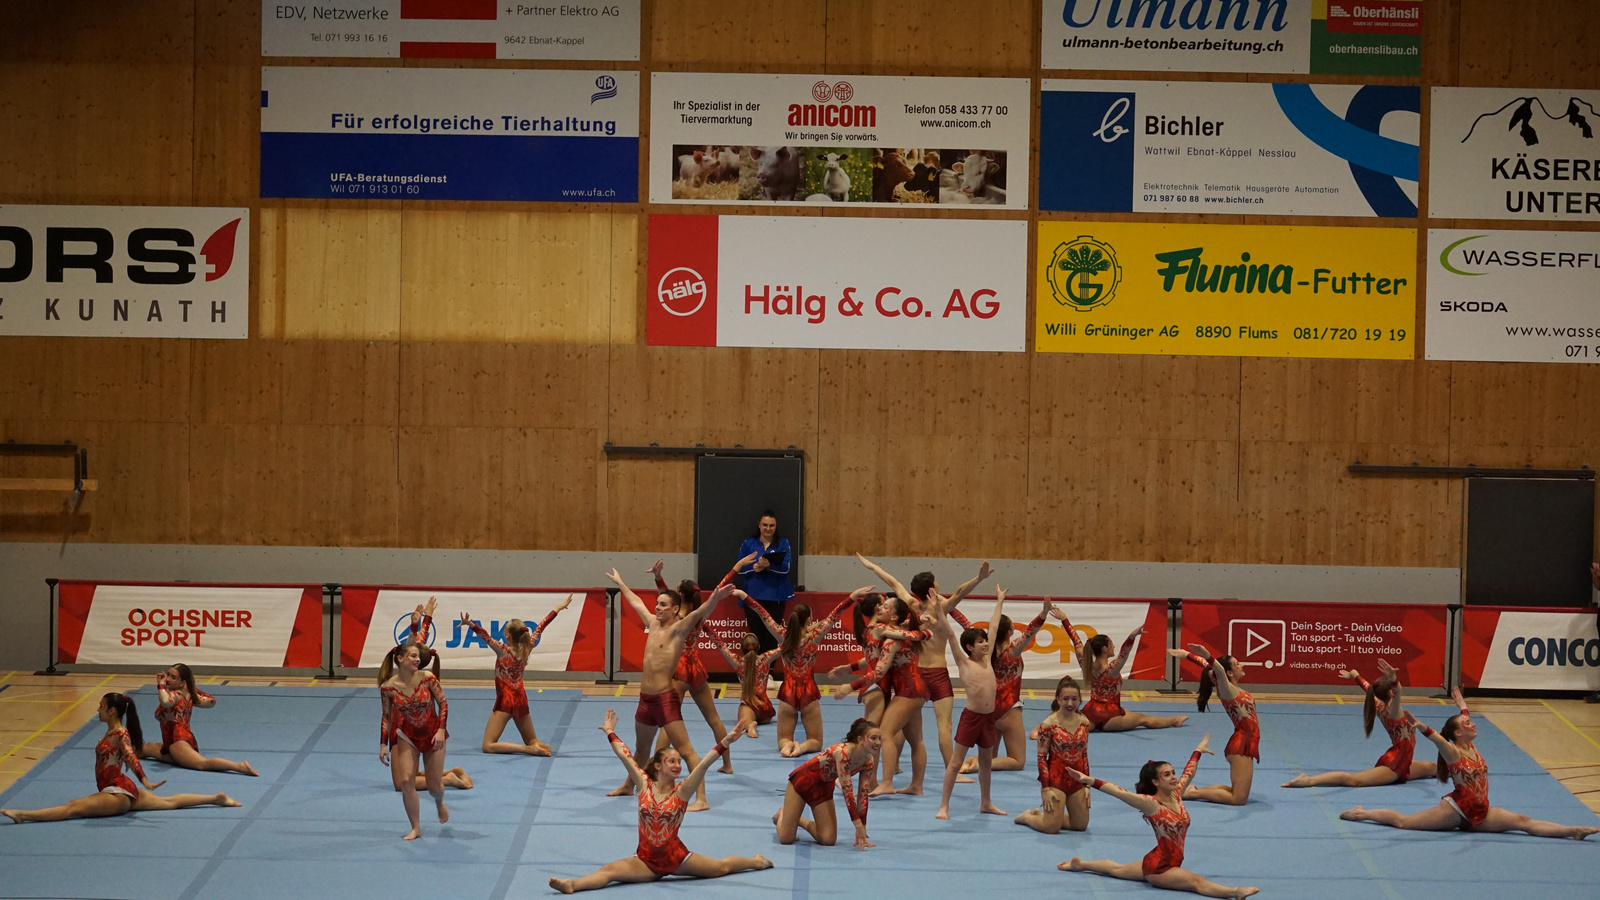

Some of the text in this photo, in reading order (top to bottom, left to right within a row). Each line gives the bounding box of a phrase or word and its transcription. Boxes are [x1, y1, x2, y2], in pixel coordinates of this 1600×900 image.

[275, 6, 389, 22] EDV, Netzwerke
[517, 5, 555, 17] Partner
[560, 5, 598, 17] Elektro
[602, 6, 620, 17] AG
[1353, 6, 1419, 20] Oberhänsli
[310, 33, 388, 43] Tel. 071 993 16 16
[504, 35, 585, 46] 9642 Ebnat-Kappel
[1062, 36, 1284, 55] ulmann-betonbearbeitung.ch
[1329, 44, 1419, 55] oberhaenslibau.ch
[597, 76, 613, 89] UFA
[673, 101, 761, 114] Ihr Spezialist in der
[904, 105, 1008, 116] Telefon 058 433 77 00
[681, 114, 752, 126] Tiervermarktung
[787, 104, 876, 128] anicom
[331, 113, 616, 135] Für erfolgreiche Tierhaltung
[920, 119, 991, 129] www.anicom.ch
[1145, 115, 1224, 137] Bichler
[785, 132, 879, 143] Wir bringen Sie vorwärts.
[1144, 146, 1181, 156] Wattwil
[1258, 148, 1296, 158] Nesslau
[1491, 153, 1600, 181] KÄSER
[330, 173, 447, 185] UFA-Beratungsdienst
[330, 185, 419, 194] Wil 071 913 01 60
[562, 188, 616, 197] www.ufa.ch
[1143, 182, 1339, 195] Elektrotechnik Telematik Hausgeräte Automation
[1143, 194, 1264, 205] 071 987 60 88 www.bichler.ch
[1506, 191, 1600, 214] UNTER
[658, 281, 706, 301] hälg
[45, 298, 226, 323] KUNATH
[744, 285, 1000, 324] Hälg & Co. AG
[1045, 323, 1406, 342] Willi Grüninger AG 8890 Flums 081/720 19 19
[1565, 345, 1588, 358] 071
[128, 608, 252, 628] OCHSNER
[1291, 621, 1313, 631] Dein
[1315, 621, 1342, 633] Sport
[1351, 622, 1373, 632] Dein
[1375, 623, 1403, 633] Video
[120, 628, 206, 647] SPORT
[1291, 632, 1307, 642] Ton
[1310, 634, 1336, 645] sport
[1344, 634, 1354, 643] Ta
[1357, 634, 1383, 643] vidéo
[1291, 644, 1296, 653] Il
[1297, 645, 1313, 654] tuo
[1316, 645, 1341, 656] sport
[1350, 646, 1356, 655] Il
[1357, 647, 1373, 655] tuo
[1376, 645, 1402, 655] video
[1508, 637, 1600, 667] CONCO
[1290, 661, 1347, 671] video.stv-fsg.ch
